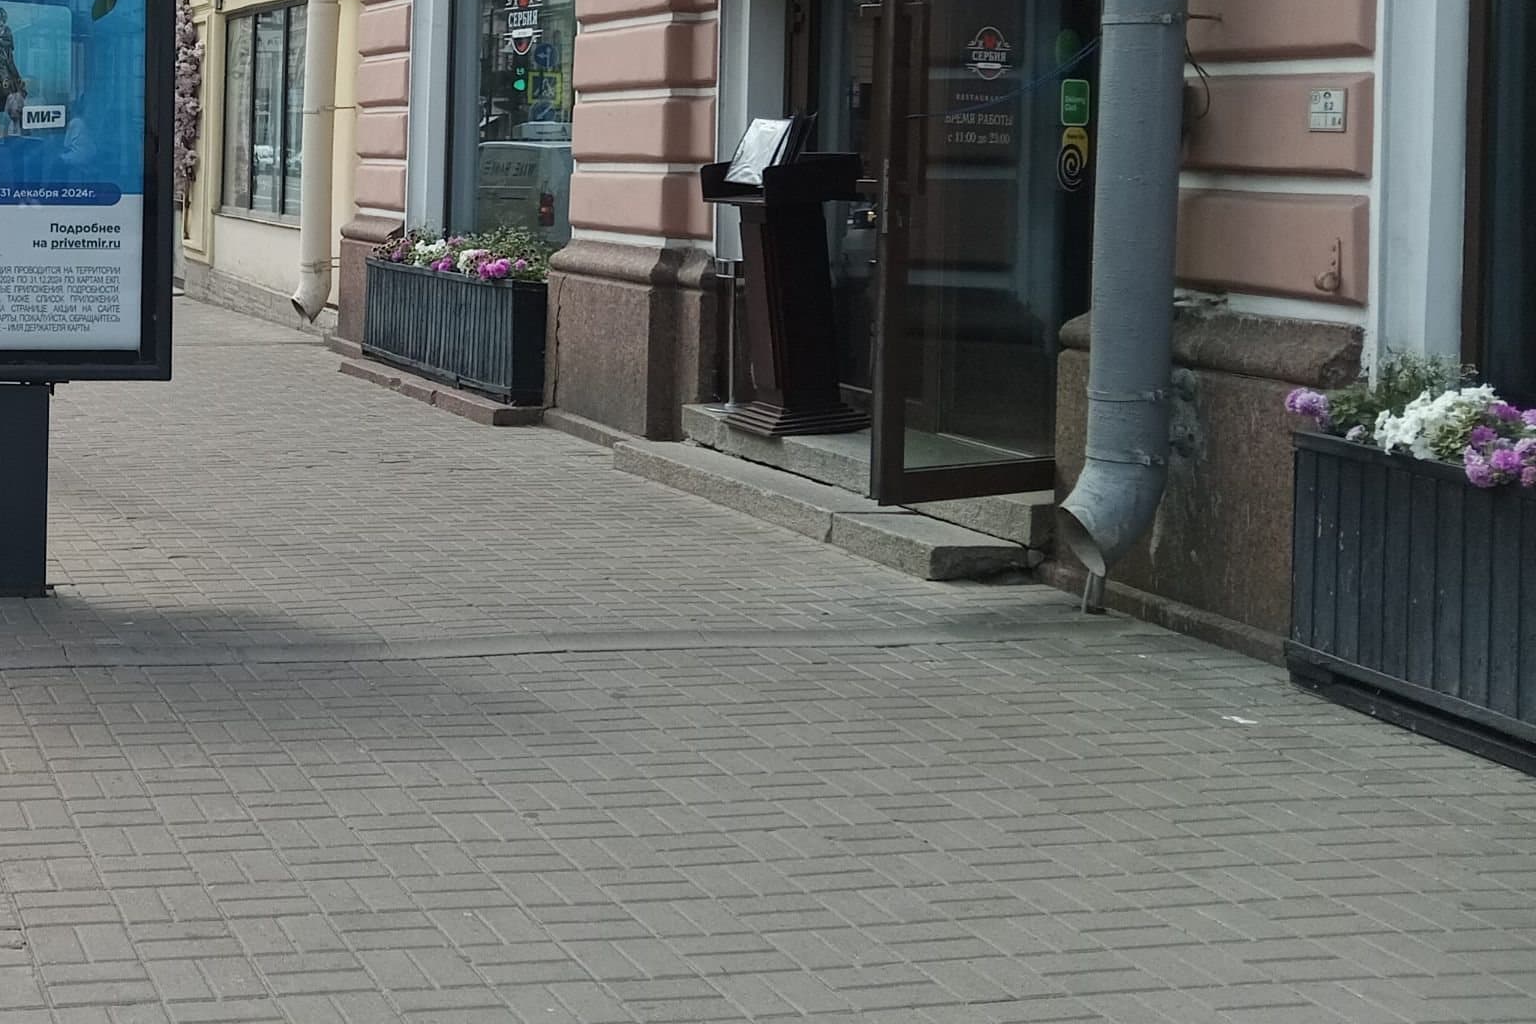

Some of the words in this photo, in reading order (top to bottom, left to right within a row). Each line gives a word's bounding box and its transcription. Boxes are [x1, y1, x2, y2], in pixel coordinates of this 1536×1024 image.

[508, 9, 539, 28] СЕРБИЯ
[972, 51, 1007, 63] СЕРБИЯ
[26, 111, 62, 124] МИР
[0, 188, 11, 197] 31
[13, 187, 59, 199] декабря
[59, 188, 96, 198] 2024г.
[50, 222, 121, 235] Подробнее
[32, 239, 48, 248] на
[50, 238, 121, 249] privetmir.ru
